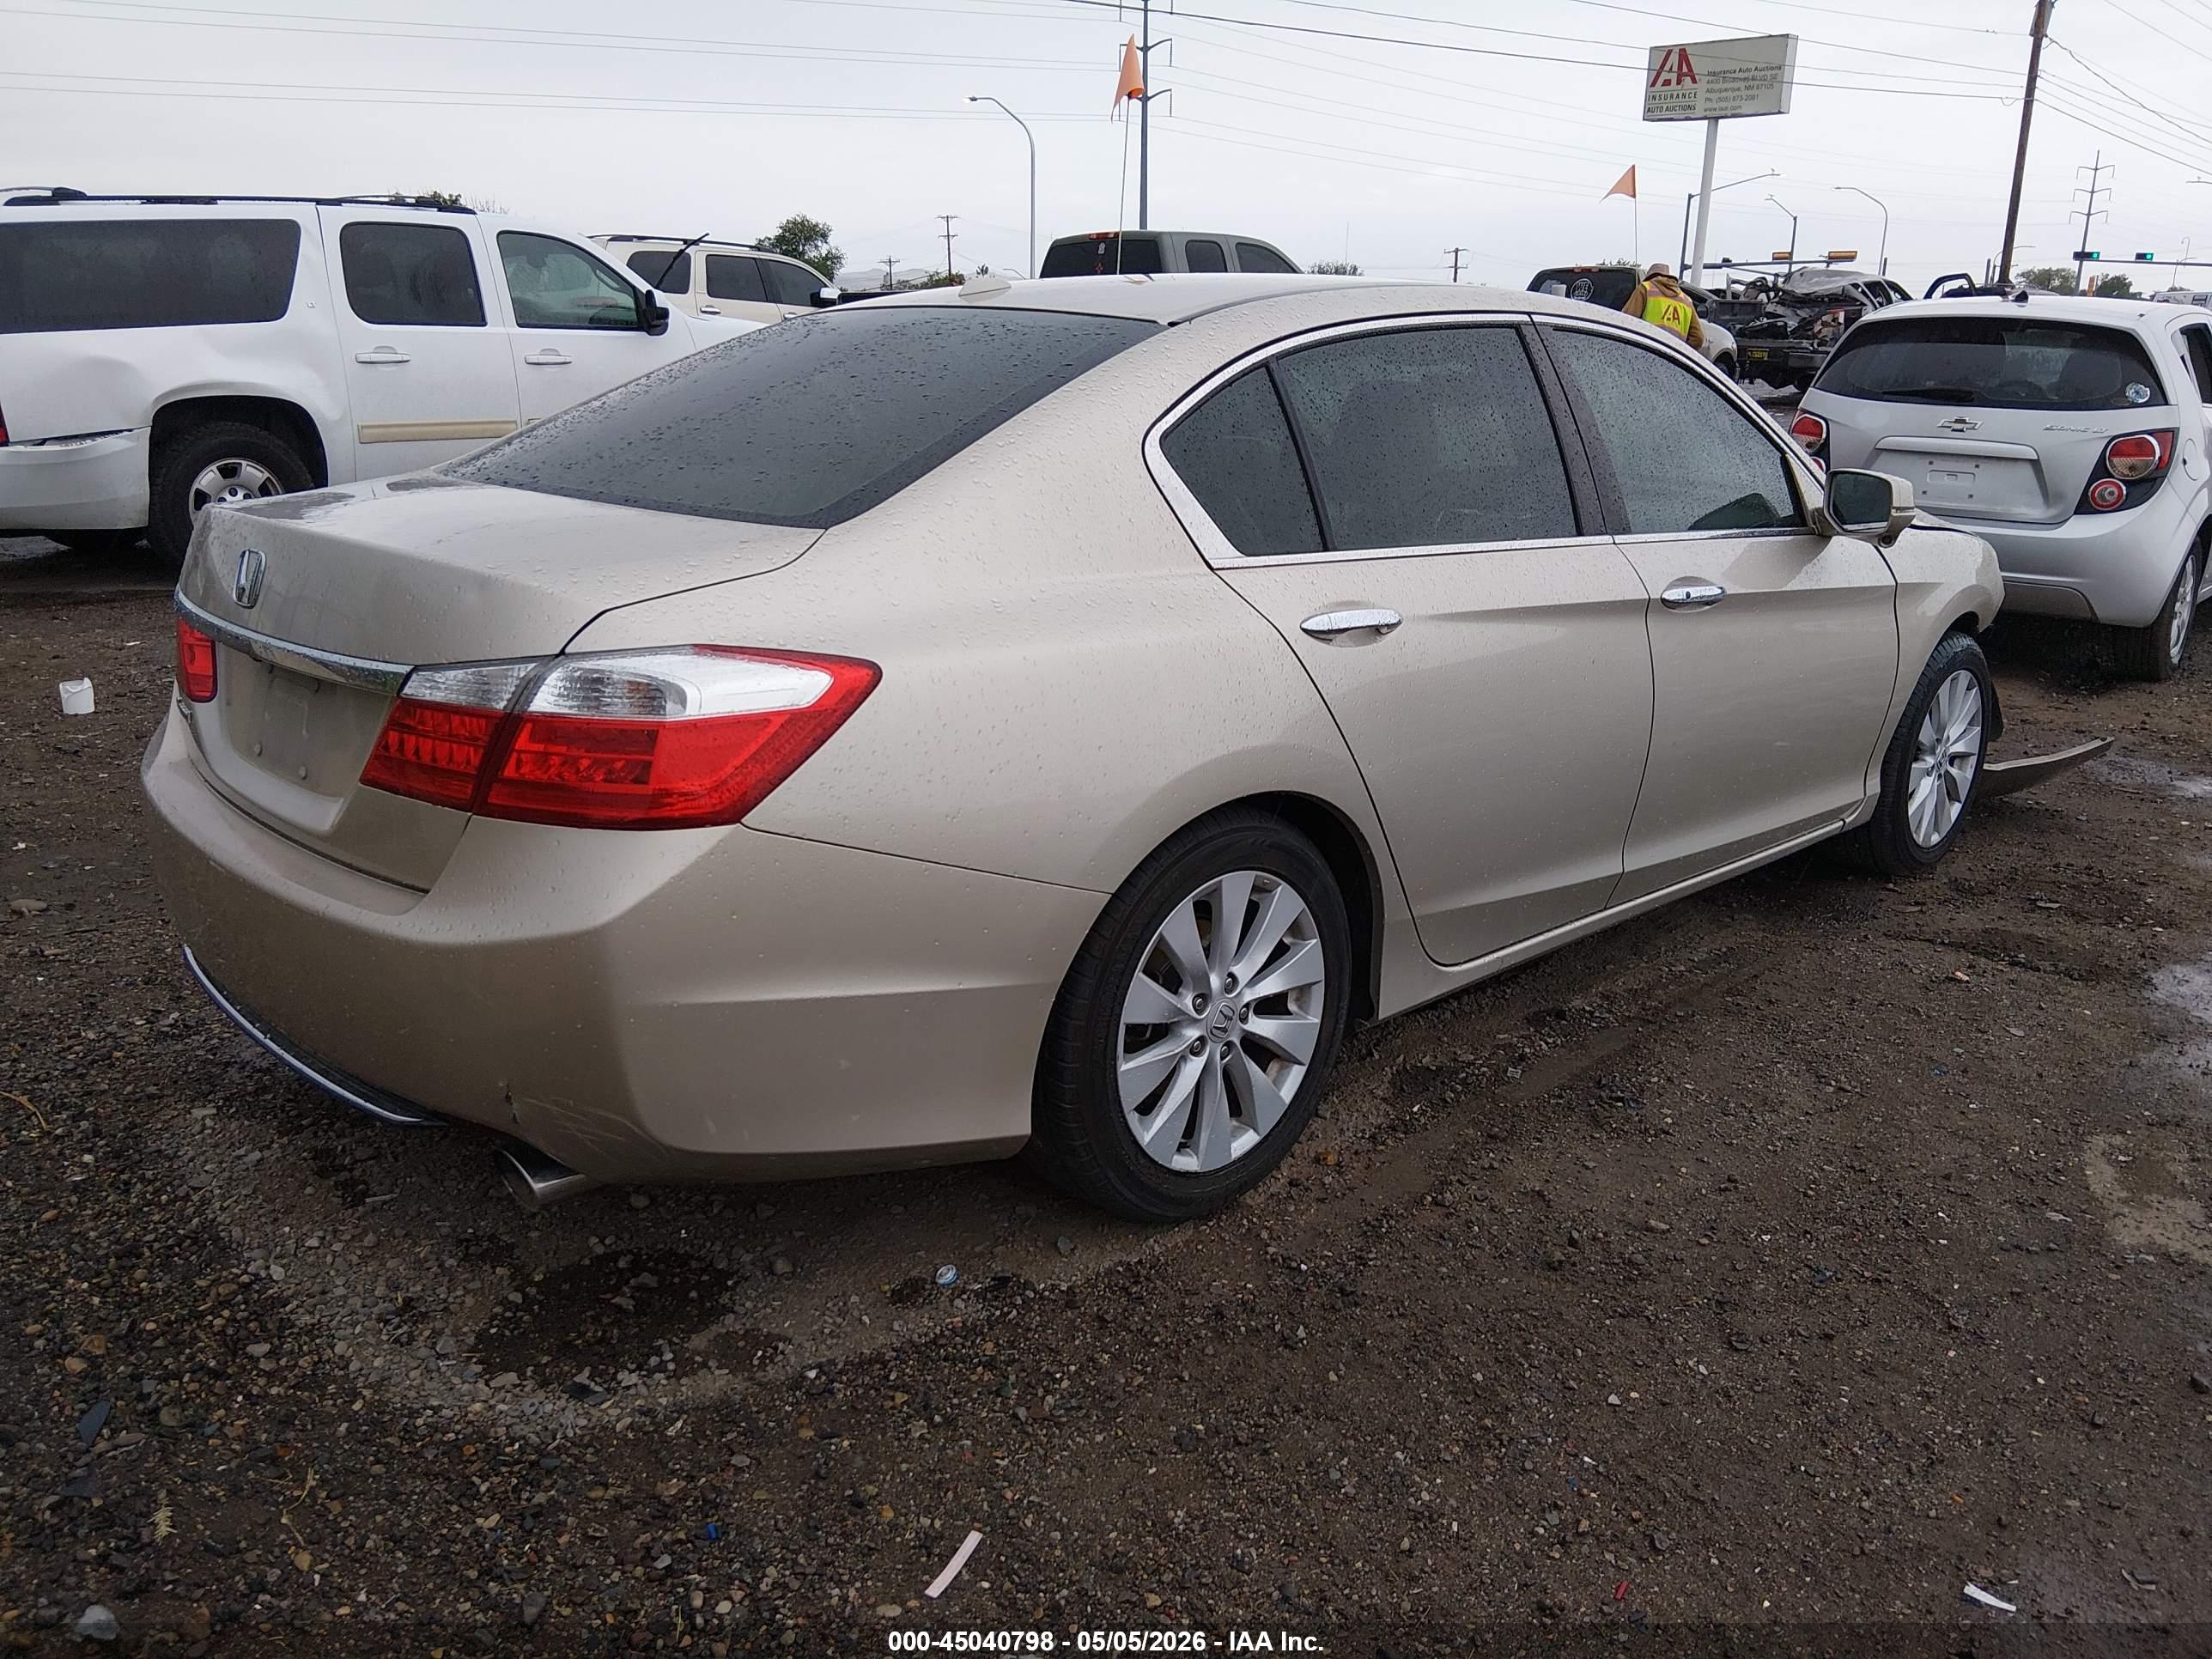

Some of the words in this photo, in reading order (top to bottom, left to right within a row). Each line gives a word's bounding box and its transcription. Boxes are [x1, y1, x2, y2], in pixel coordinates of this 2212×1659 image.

[1707, 68, 1736, 76] Insurance
[1648, 91, 1698, 102] INSURANCE
[1664, 104, 1697, 112] AUCTIONS
